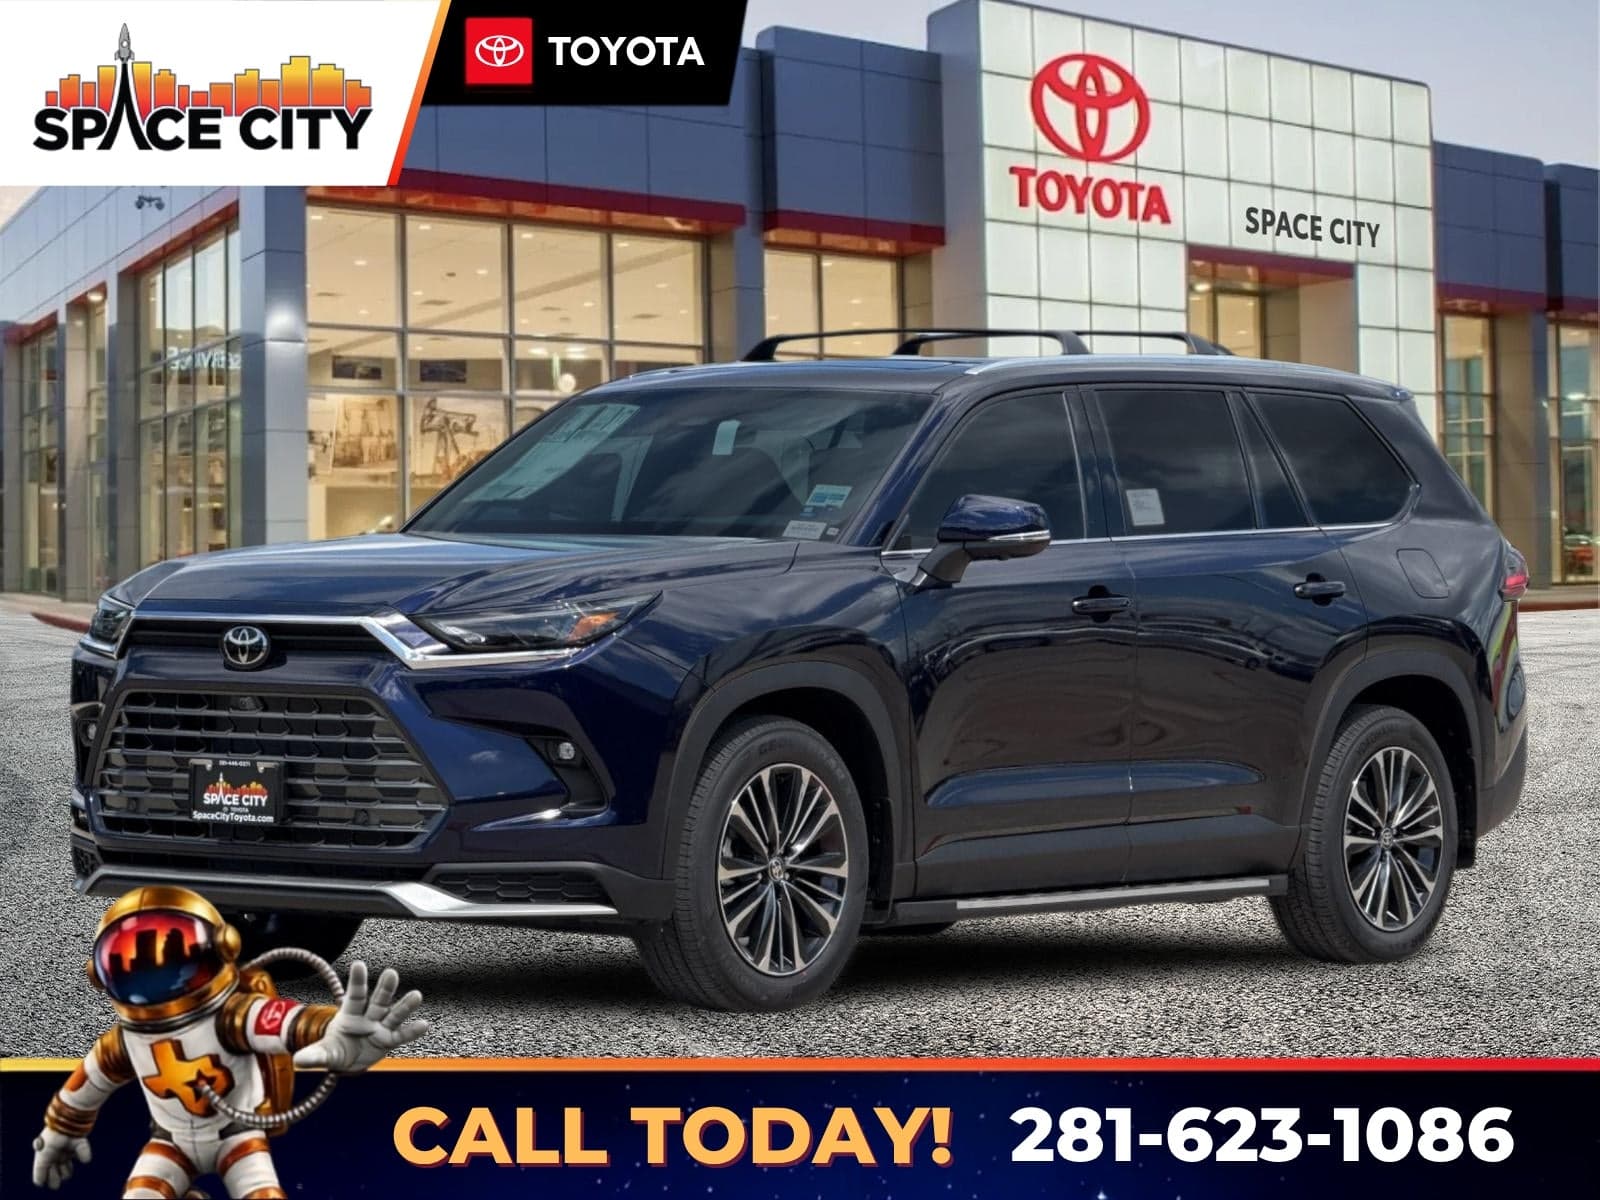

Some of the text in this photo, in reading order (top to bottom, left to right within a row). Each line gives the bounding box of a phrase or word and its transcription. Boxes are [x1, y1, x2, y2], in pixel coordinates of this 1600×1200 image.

[1009, 166, 1171, 224] TOYOTA
[1244, 206, 1381, 248] SPACE CITY
[203, 791, 268, 807] SPACE CITY
[192, 810, 274, 823] SpaceCityToyota.com
